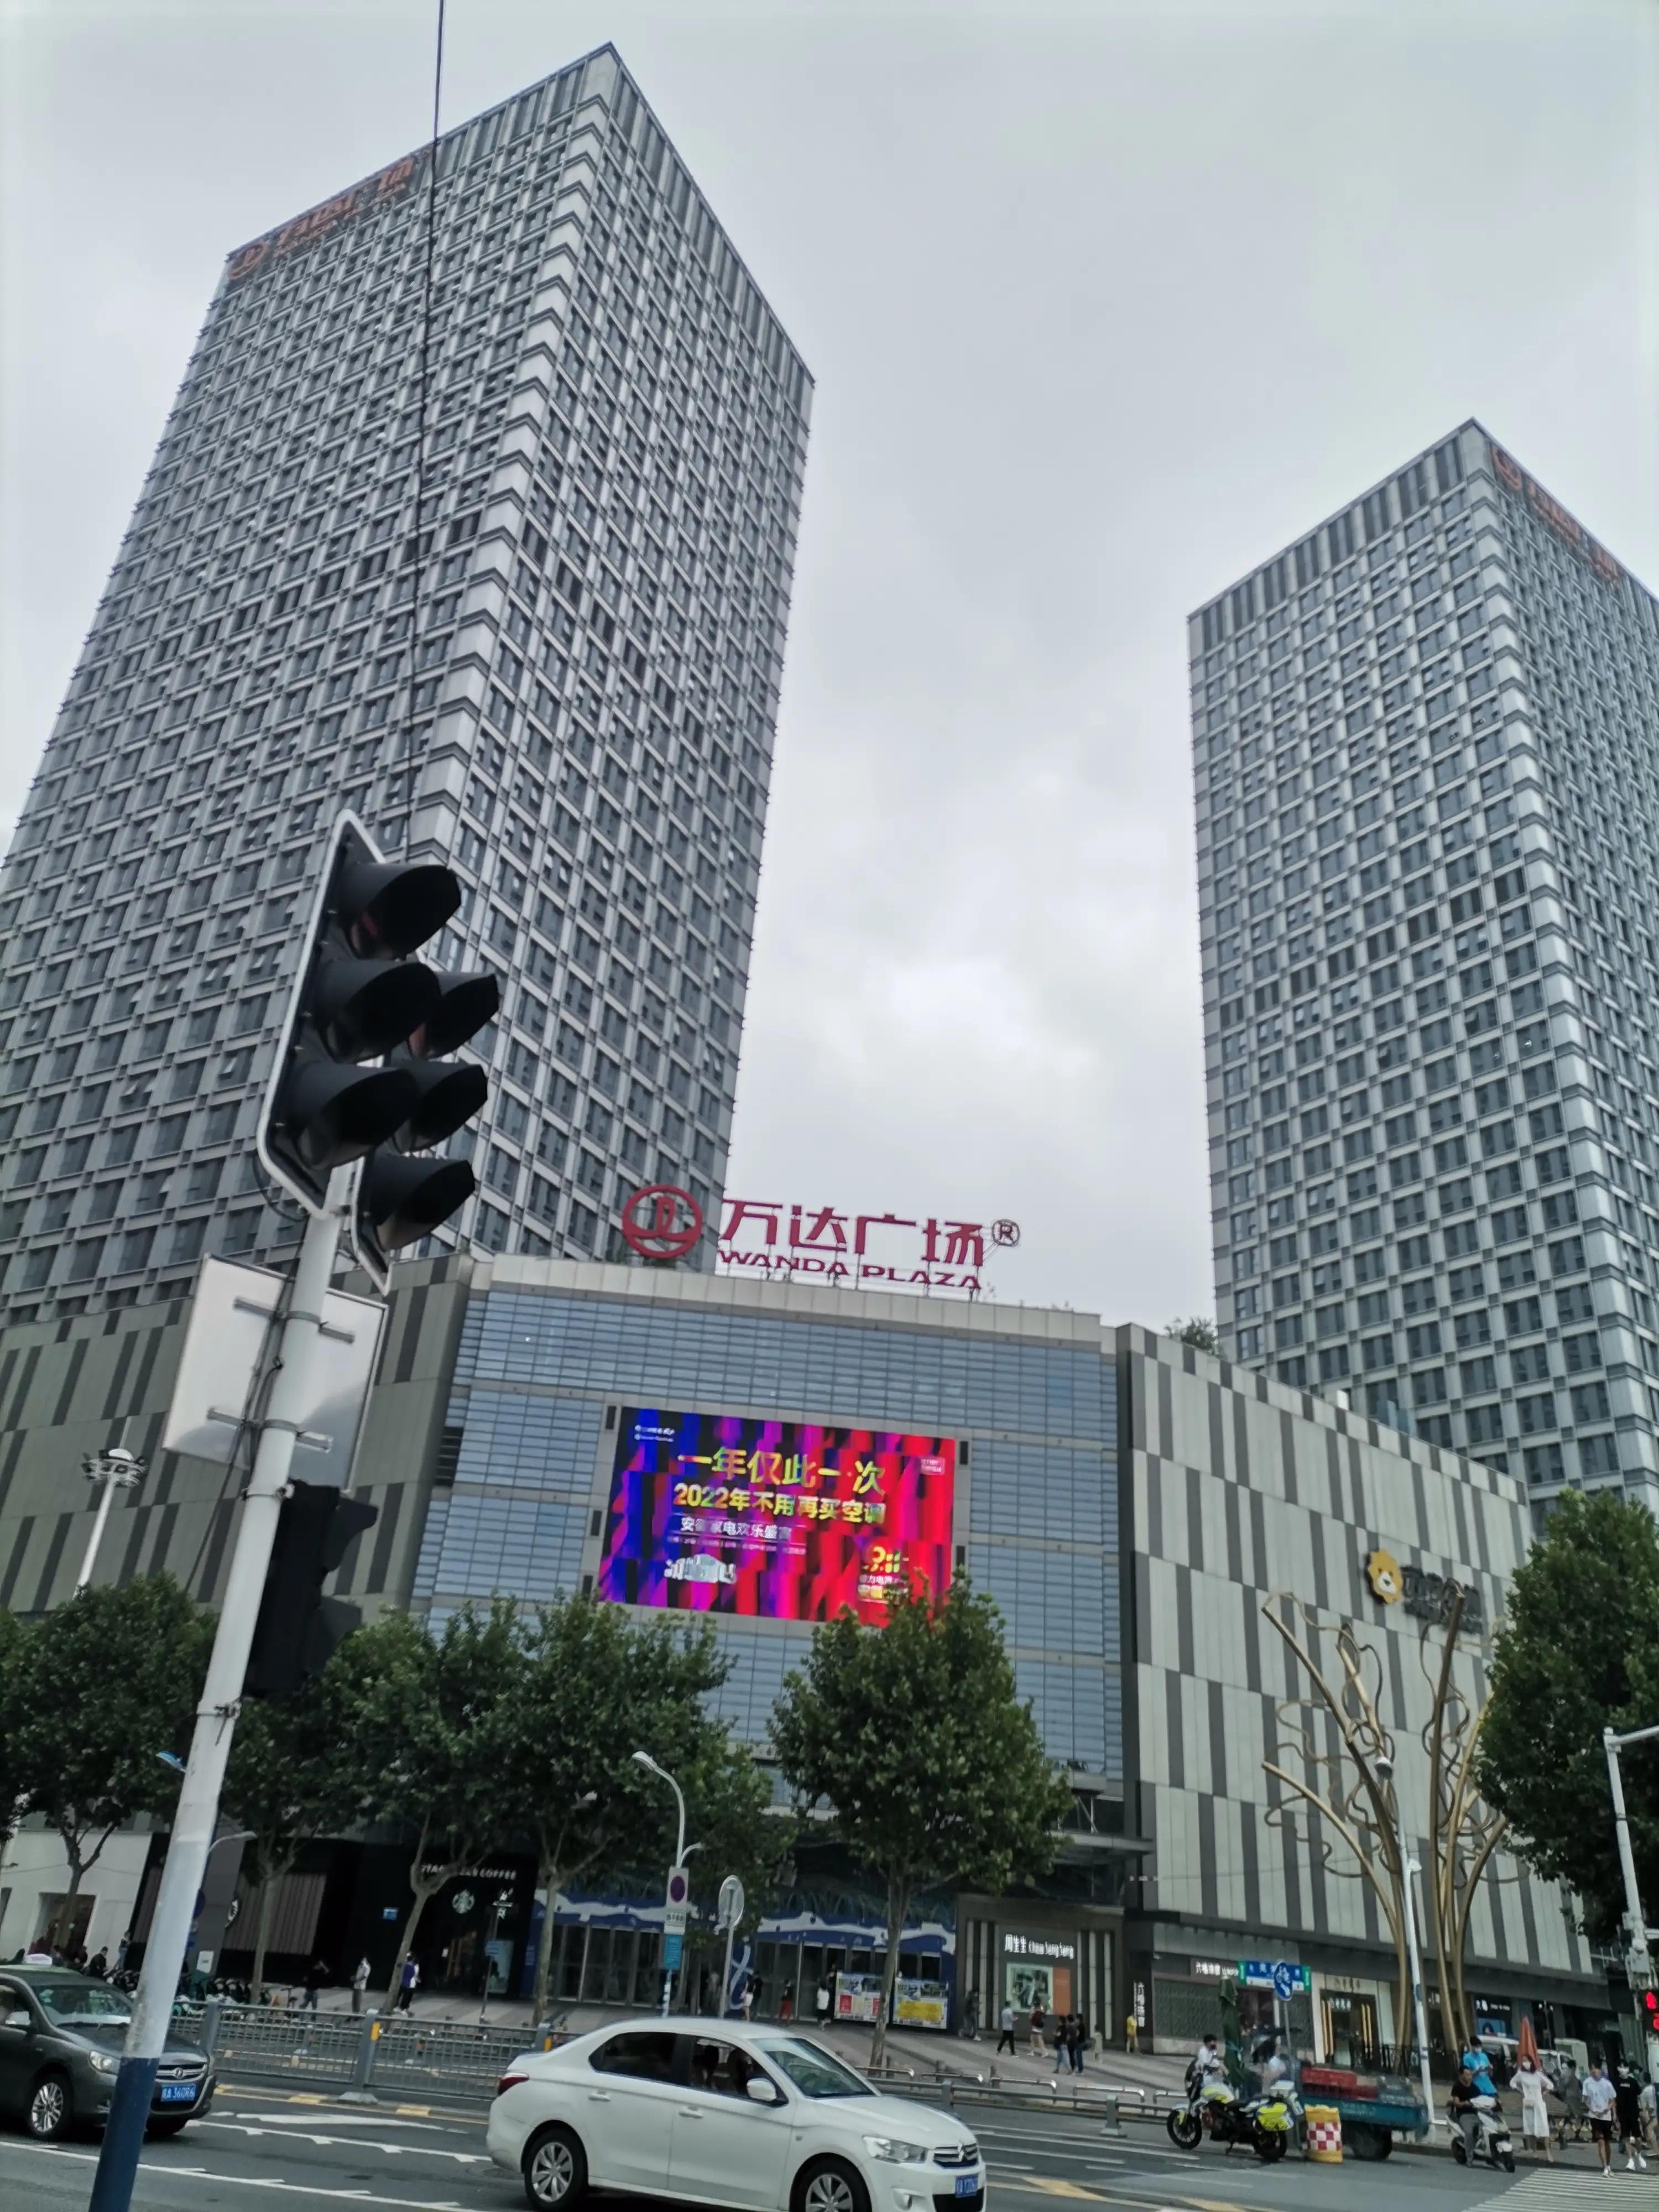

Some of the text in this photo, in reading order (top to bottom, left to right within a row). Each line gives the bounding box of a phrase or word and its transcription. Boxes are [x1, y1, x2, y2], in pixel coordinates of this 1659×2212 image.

[720, 1199, 983, 1266] 万达广场
[717, 1250, 982, 1289] WANDA PLAZA
[677, 1447, 886, 1495] 一年仅此一次
[673, 1483, 886, 1524] 2022年不用再买空调
[479, 1868, 517, 1880] COFFEE
[1004, 1934, 1026, 1954] 周生生
